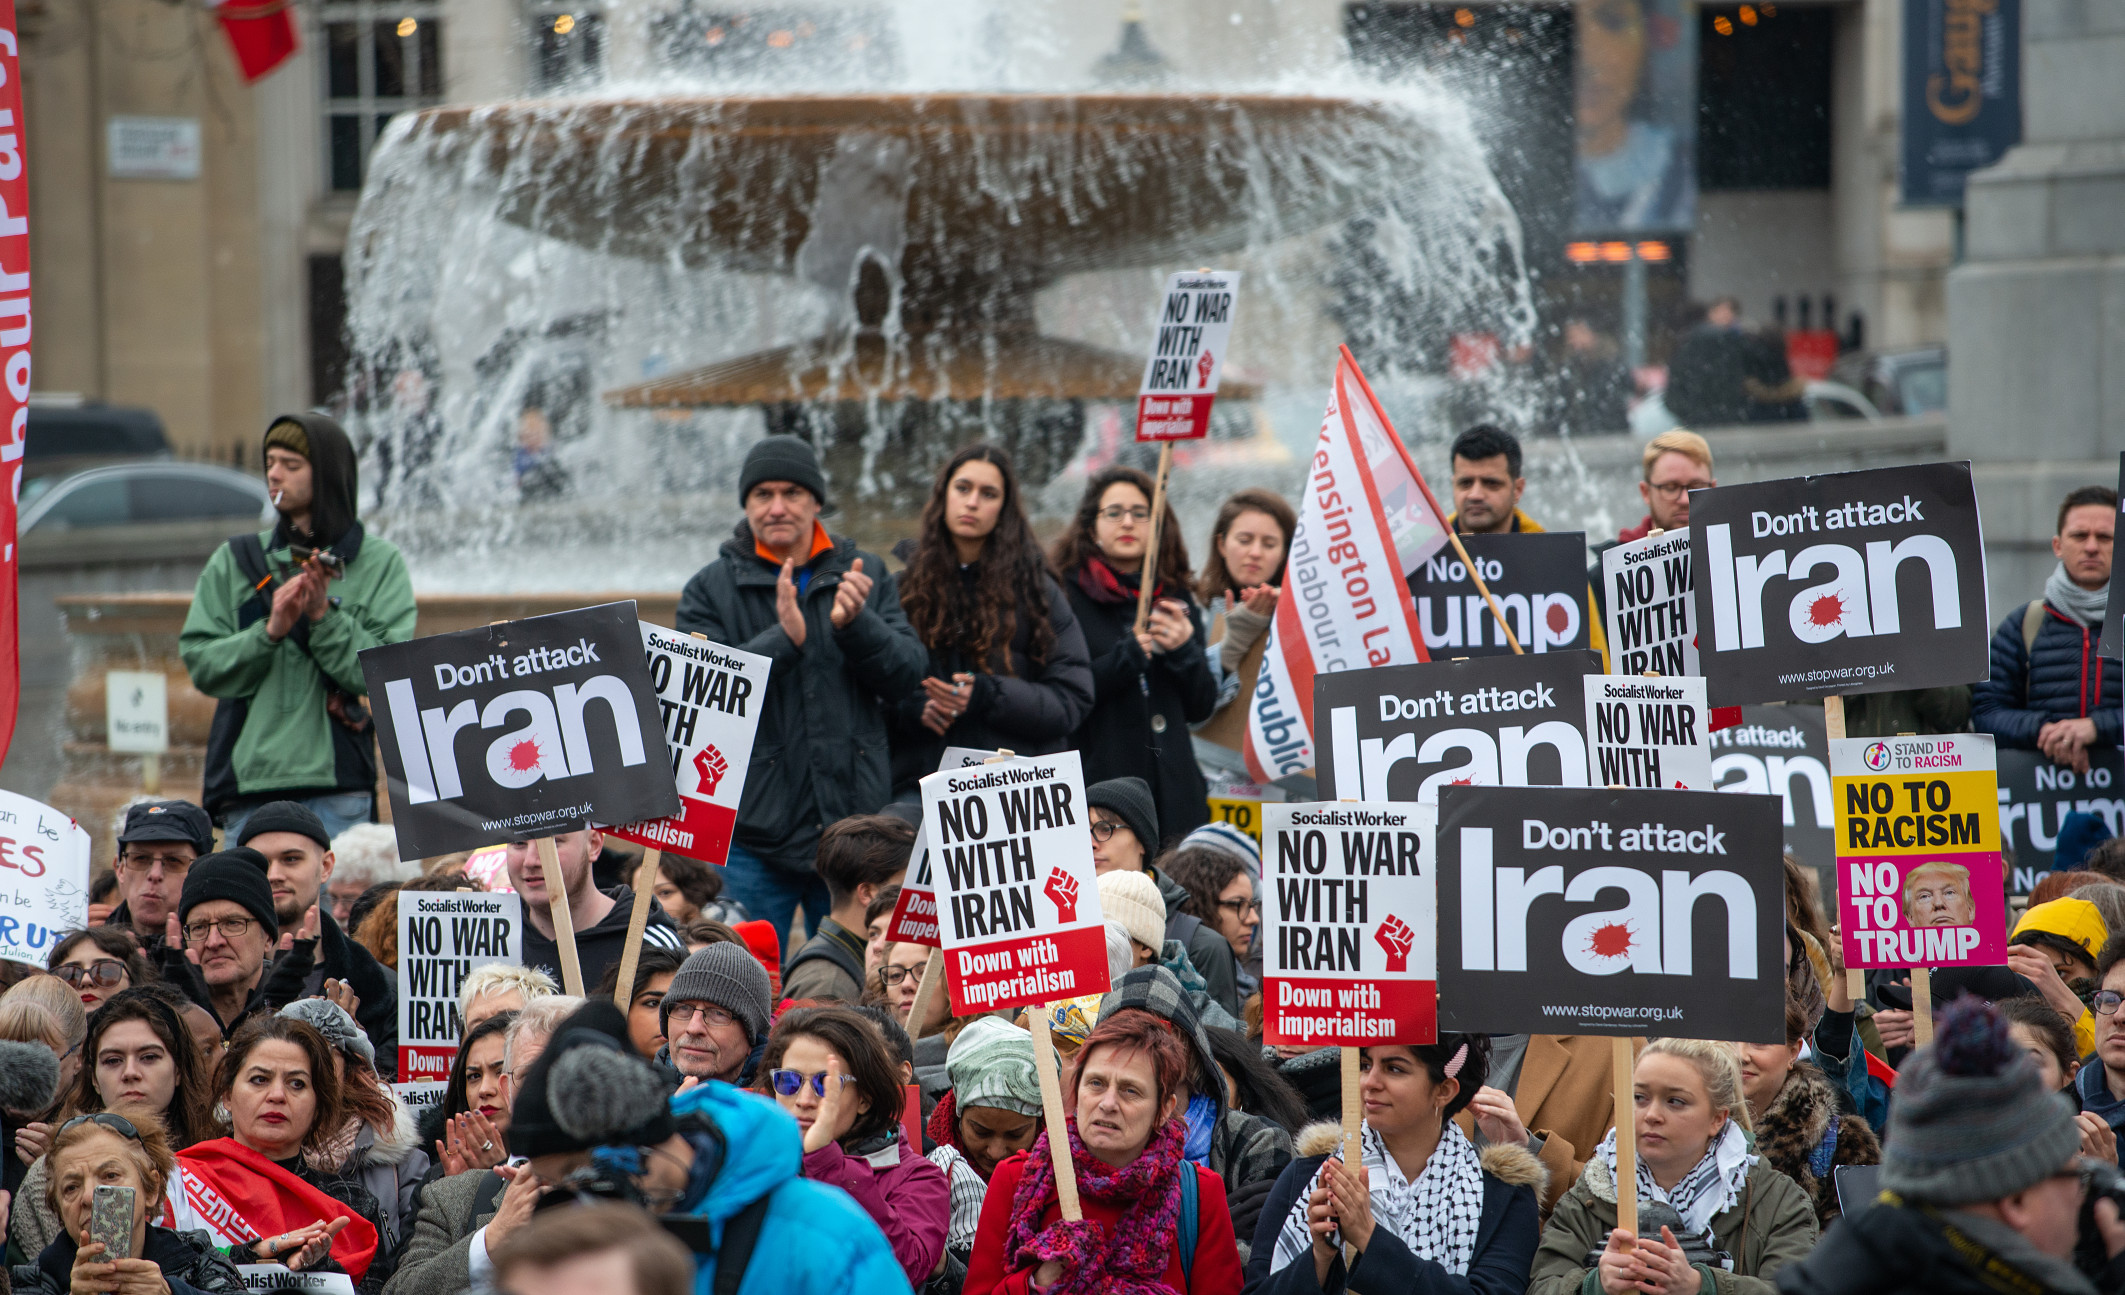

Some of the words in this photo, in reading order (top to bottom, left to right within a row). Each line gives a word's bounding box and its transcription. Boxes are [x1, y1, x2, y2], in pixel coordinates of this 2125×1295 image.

[1163, 292, 1190, 323] NO
[1194, 292, 1232, 323] WAR
[1157, 326, 1203, 356] WITH
[1149, 359, 1193, 389] IRAN
[1144, 397, 1170, 415] Down
[1172, 397, 1193, 414] with
[1752, 506, 1820, 538] Don't
[1825, 495, 1925, 530] attack
[1427, 556, 1467, 583] No
[1474, 556, 1504, 582] to
[1615, 565, 1654, 611] NO
[1663, 554, 1694, 598] W
[1706, 534, 1962, 652] Iran
[1411, 592, 1581, 654] ump
[1617, 596, 1688, 651] WITH
[434, 654, 510, 691] Don't
[513, 638, 601, 677] attack
[1362, 625, 1392, 668] La
[1621, 639, 1686, 676] IRAN
[647, 651, 672, 695] O
[681, 662, 753, 718] WAR
[1778, 662, 1895, 685] www.stopwar.org.uk
[1379, 690, 1455, 722] Don't
[1460, 682, 1557, 715] attack
[384, 674, 647, 805] Iran
[1595, 702, 1631, 745] NO
[1638, 703, 1698, 746] WAR
[1735, 724, 1807, 749] attack
[1331, 704, 1593, 803] Iran
[1597, 746, 1662, 788] WITH
[1895, 742, 1934, 756] STAND
[1937, 741, 1955, 754] UP
[1895, 757, 1912, 769] TO
[1915, 754, 1962, 769] RACISM
[2034, 765, 2076, 791] No
[2085, 767, 2112, 789] to
[937, 795, 988, 844] NO
[998, 782, 1076, 835] WAR
[1220, 804, 1251, 828] TO
[1846, 782, 1894, 815] NO
[1903, 780, 1951, 813] TO
[37, 815, 59, 841] be
[482, 802, 594, 832] www.stopwar.org.uk
[1848, 812, 1981, 849] RACISM
[1997, 787, 2125, 851] rum
[1278, 829, 1327, 875] NO
[1341, 830, 1421, 876] WAR
[1522, 819, 1613, 850] Don't
[1619, 823, 1728, 855] attack
[943, 836, 1036, 892] WITH
[1850, 861, 1900, 896] NO
[14, 888, 32, 908] be
[905, 893, 938, 915] Dow
[950, 884, 1036, 940] IRAN
[1276, 877, 1368, 924] WITH
[1460, 827, 1759, 980] Iran
[1851, 896, 1899, 929] TO
[1, 944, 34, 961] Julian
[408, 916, 442, 956] NO
[451, 917, 511, 957] WAR
[1278, 926, 1361, 972] IRAN
[1853, 927, 1981, 963] TRUMP
[958, 949, 1012, 977] Down
[1017, 938, 1059, 968] with
[407, 958, 471, 998] WITH
[962, 968, 1076, 1007] imperialism
[1278, 981, 1332, 1008] Down
[1338, 983, 1381, 1009] with
[1278, 1010, 1396, 1041] imperialism
[1542, 1003, 1684, 1021] www.stopwar.org.uk
[408, 1049, 444, 1073] Down
